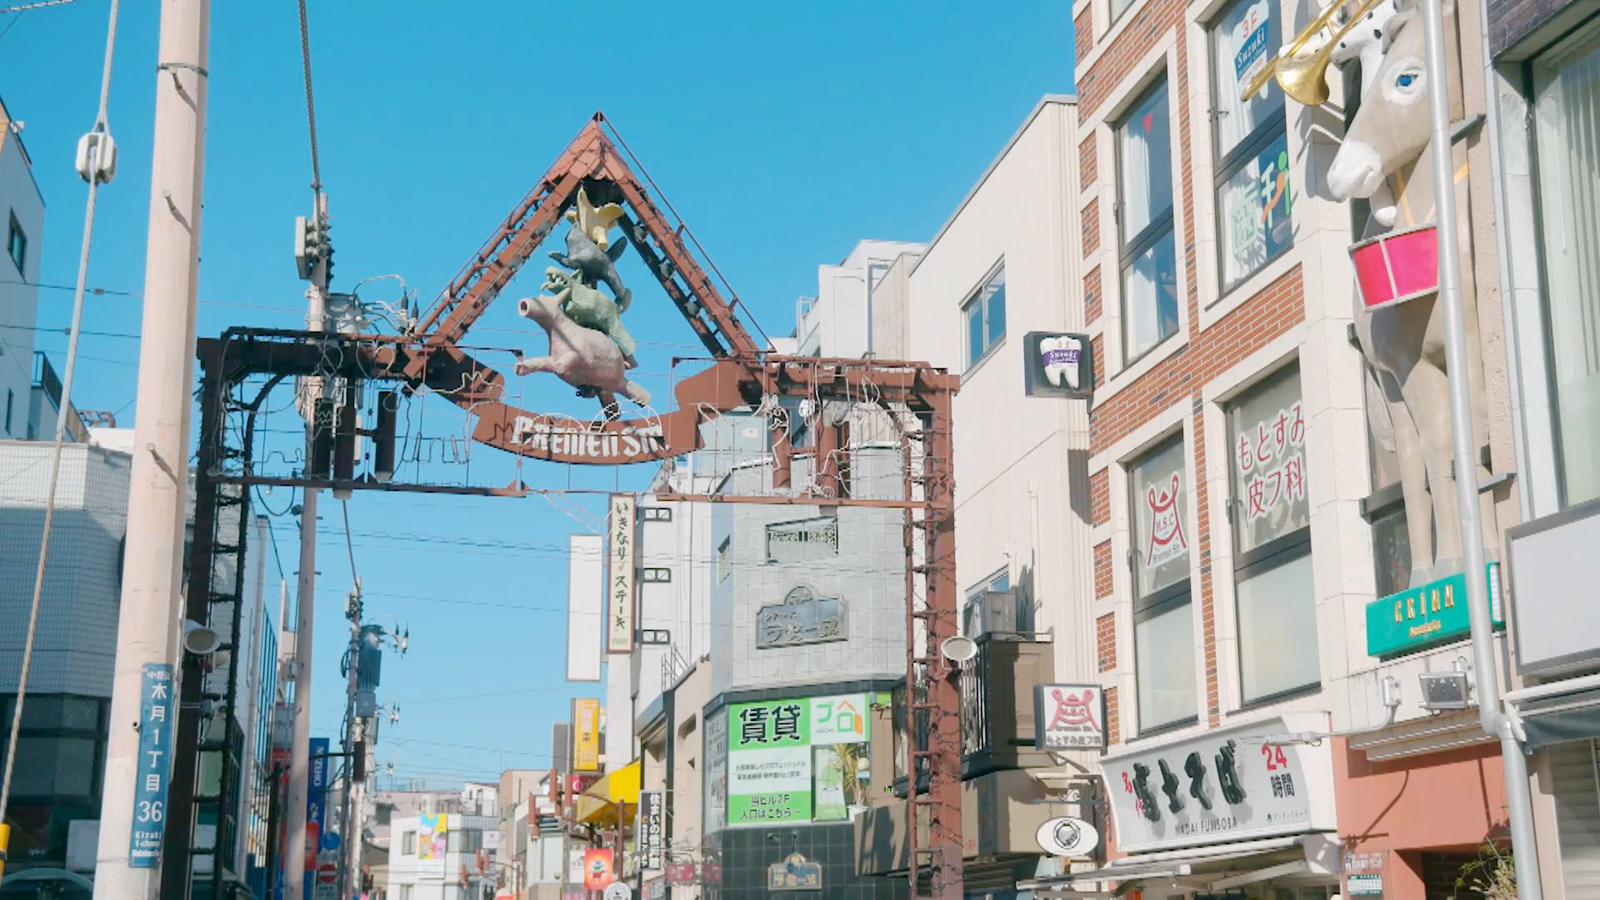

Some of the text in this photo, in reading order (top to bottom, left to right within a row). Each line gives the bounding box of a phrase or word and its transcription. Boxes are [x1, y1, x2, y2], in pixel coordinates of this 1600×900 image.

[1242, 9, 1258, 38] 3F
[1238, 27, 1265, 67] Suzuki
[1238, 404, 1305, 471] もとすみ
[1248, 456, 1305, 520] 皮フ科
[739, 704, 801, 745] 賃貸
[313, 745, 325, 787] MZUHO
[1261, 745, 1288, 772] 24
[1270, 773, 1296, 799] 時間
[137, 800, 163, 823] 36
[1175, 815, 1238, 836] NADAI FUJISOBA
